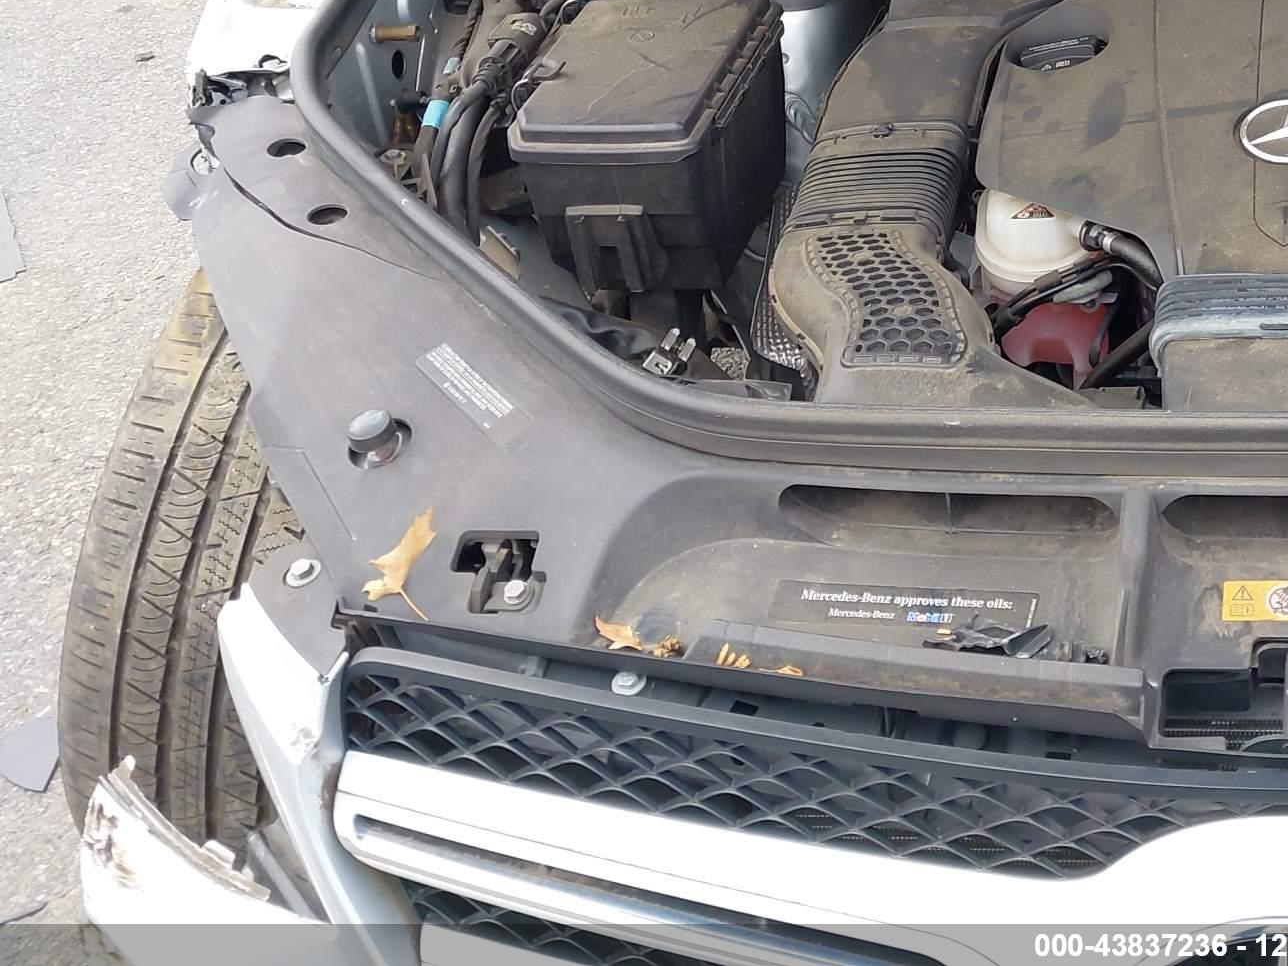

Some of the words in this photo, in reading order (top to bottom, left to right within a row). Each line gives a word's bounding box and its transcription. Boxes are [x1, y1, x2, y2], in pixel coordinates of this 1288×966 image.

[801, 589, 892, 604] Mercedes-Benz
[893, 595, 949, 608] approves
[950, 595, 985, 608] these
[986, 598, 1013, 610] oils:
[828, 607, 896, 620] Mercedes-Benz
